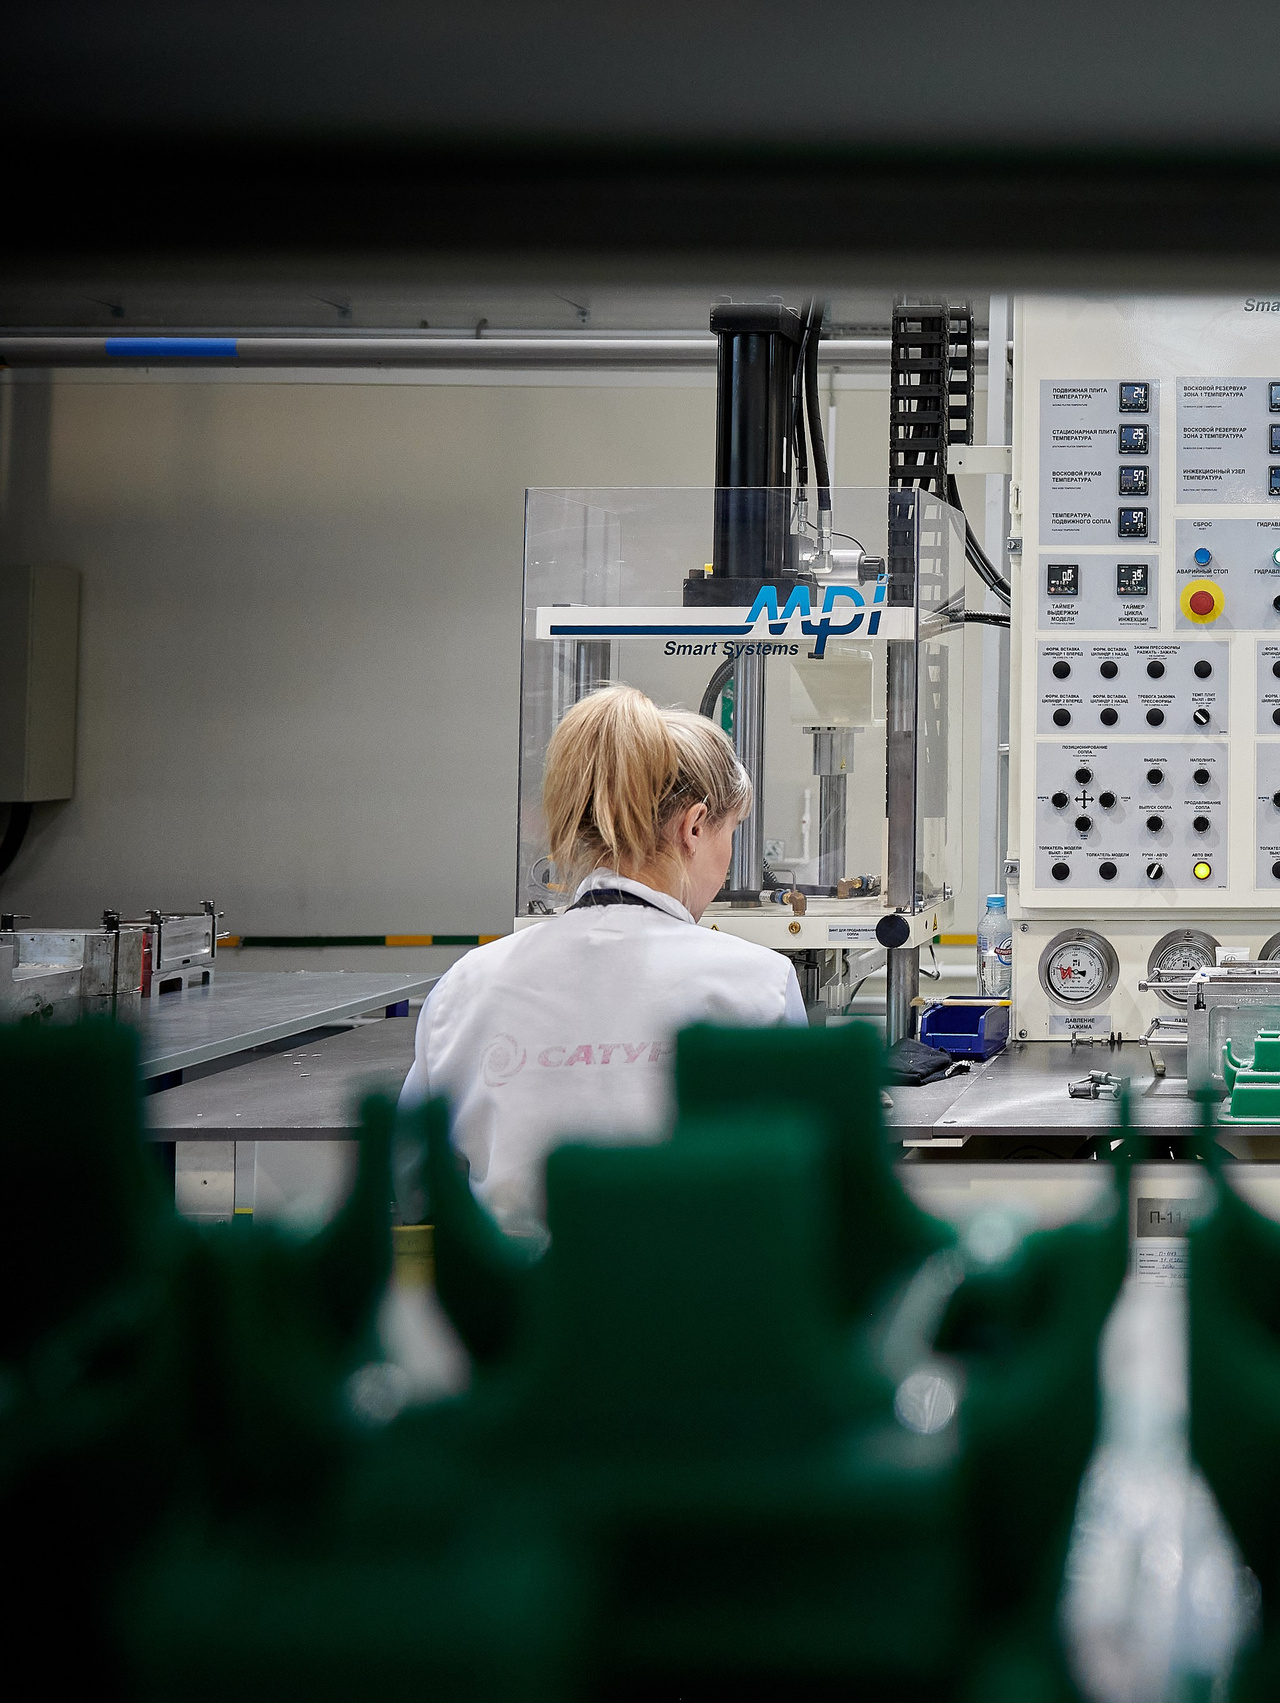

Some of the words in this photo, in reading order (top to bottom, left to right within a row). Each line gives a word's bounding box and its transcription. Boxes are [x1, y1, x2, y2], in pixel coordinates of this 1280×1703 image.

[664, 640, 719, 656] Smart
[722, 640, 799, 659] Systems
[537, 1040, 677, 1067] САТУР
